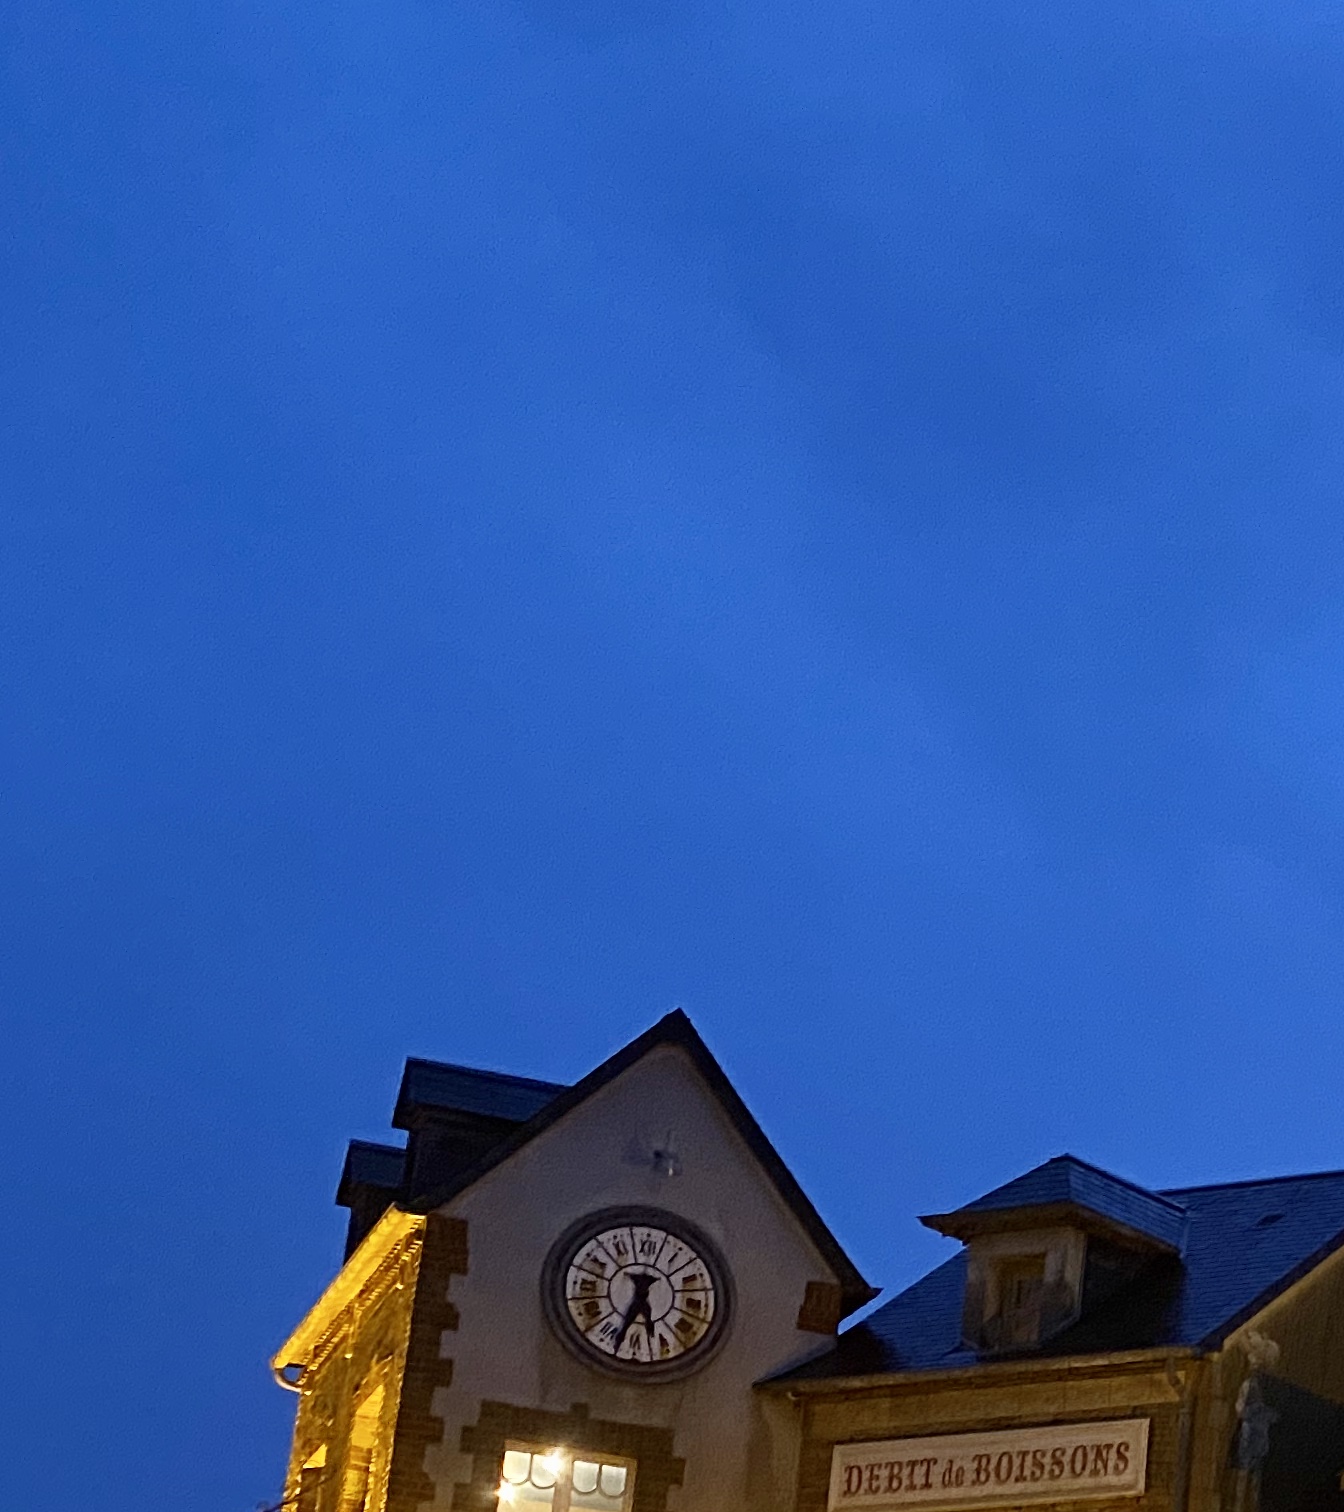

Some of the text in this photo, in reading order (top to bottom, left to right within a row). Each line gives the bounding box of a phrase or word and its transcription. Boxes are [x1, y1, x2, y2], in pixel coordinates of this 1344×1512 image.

[843, 1441, 1131, 1499] DEBIT de BOISSONS
